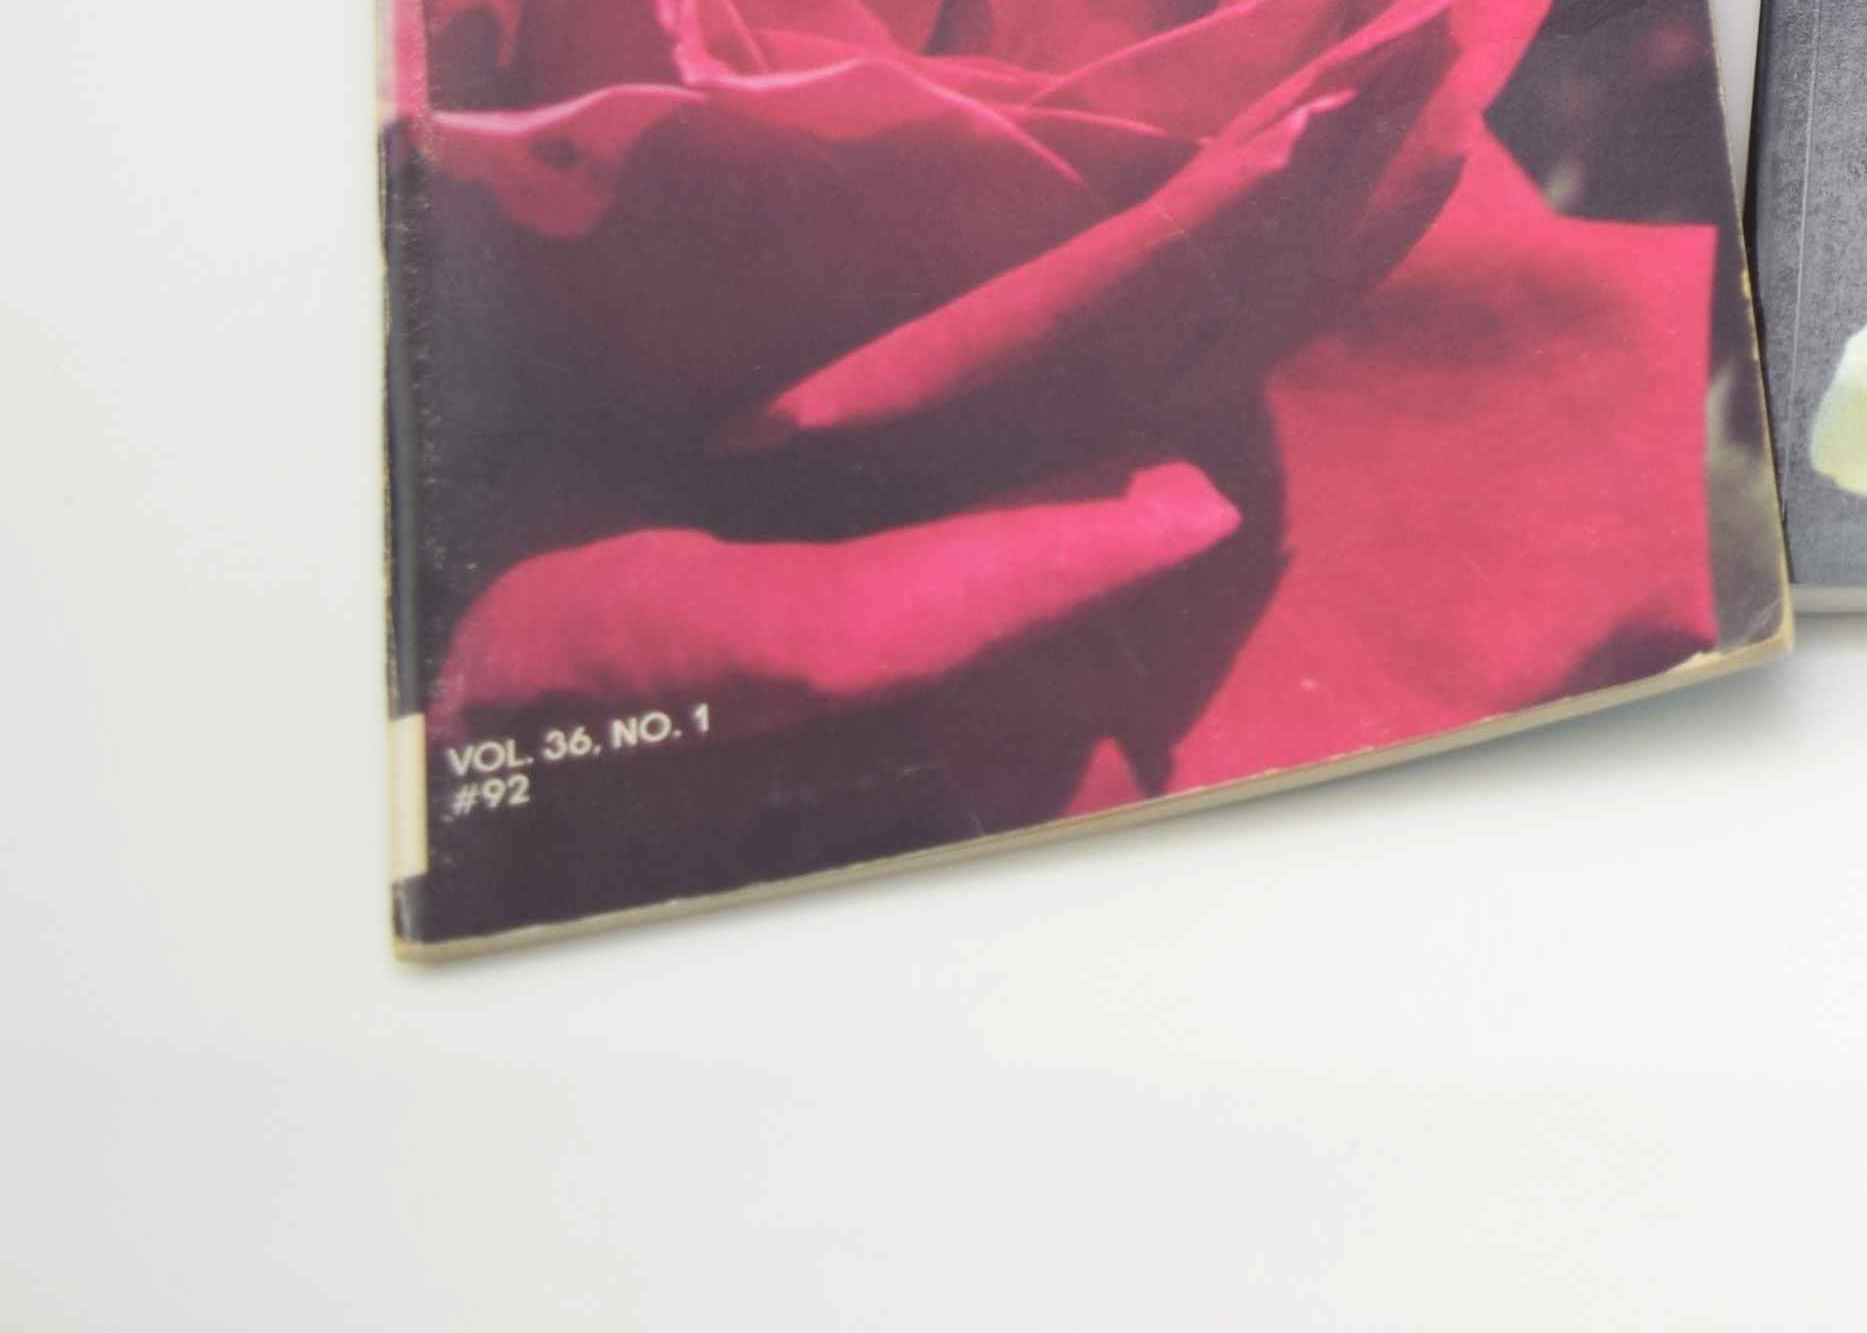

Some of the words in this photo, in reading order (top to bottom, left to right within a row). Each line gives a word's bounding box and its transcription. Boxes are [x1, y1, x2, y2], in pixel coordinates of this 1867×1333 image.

[446, 740, 534, 776] VOL.
[542, 727, 602, 762] 36,
[610, 710, 683, 751] NO.
[692, 703, 711, 733] 1
[452, 774, 531, 817] #92
